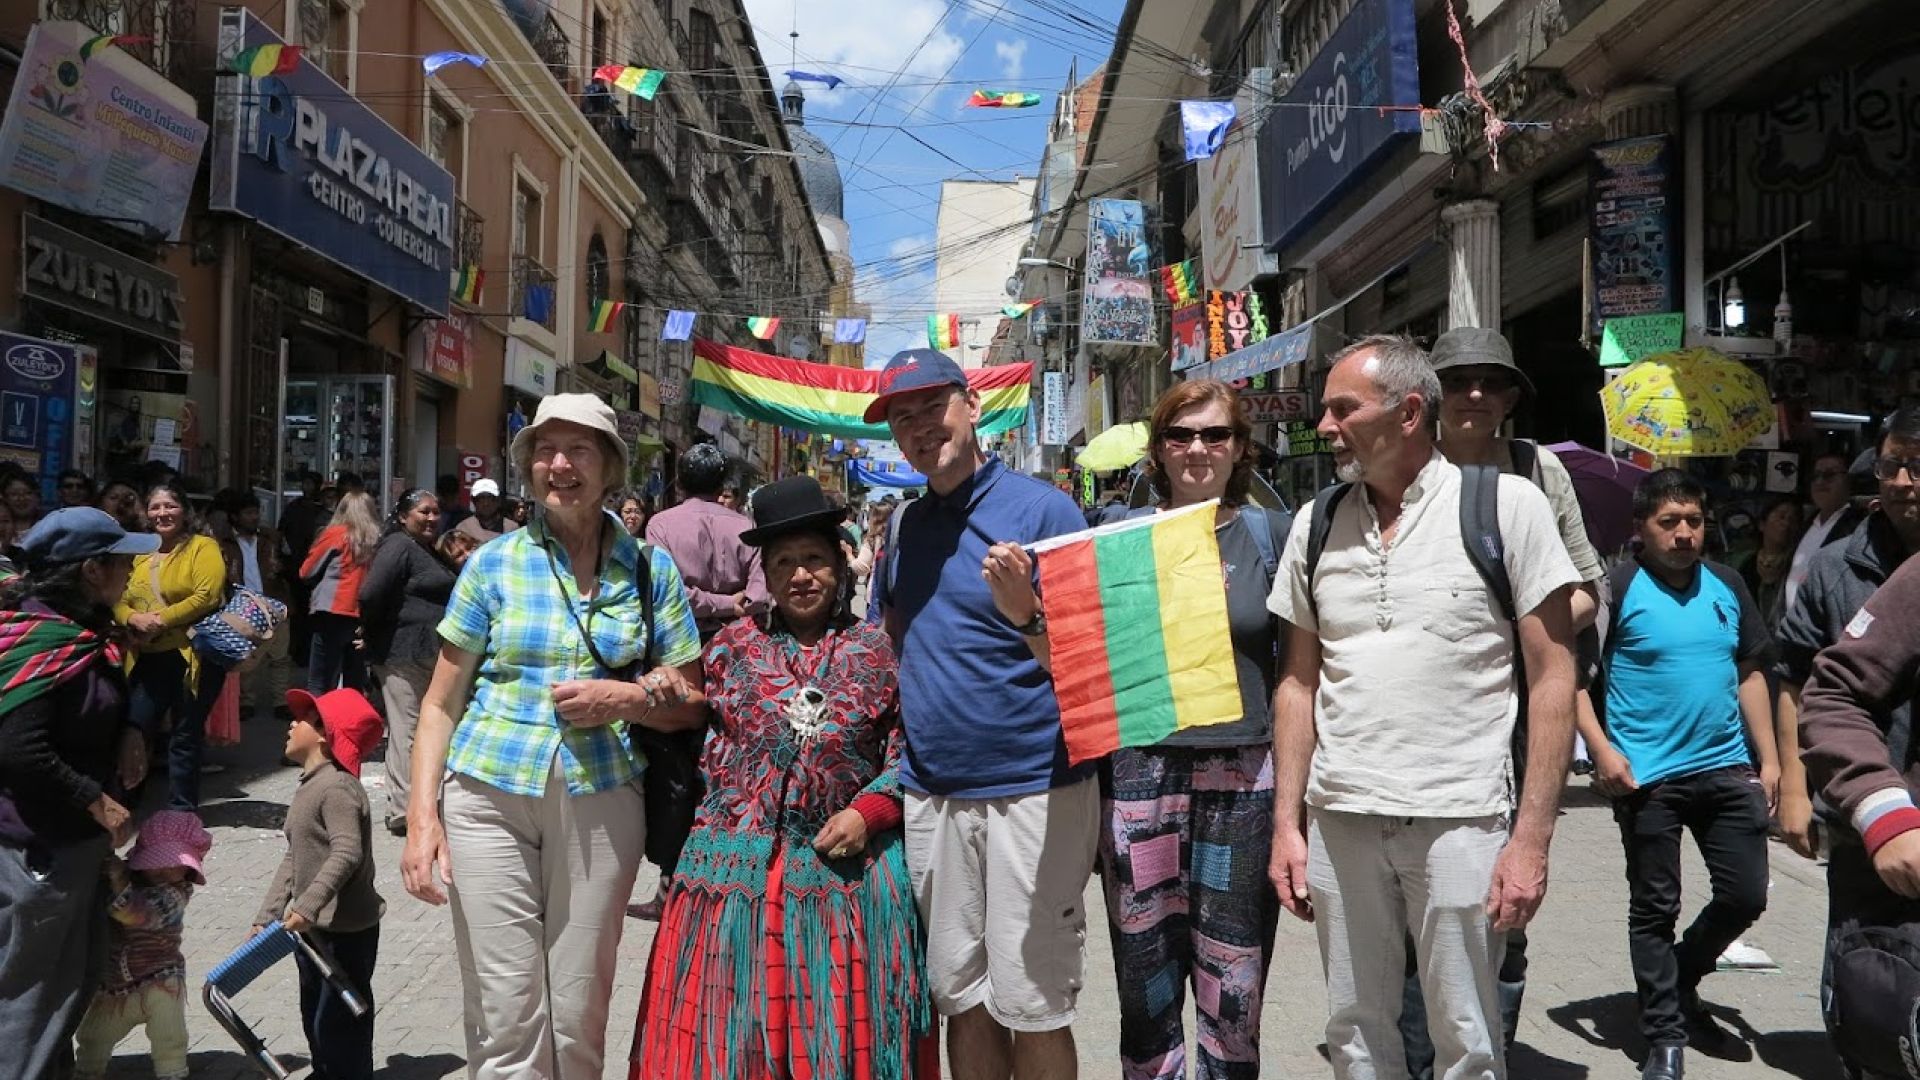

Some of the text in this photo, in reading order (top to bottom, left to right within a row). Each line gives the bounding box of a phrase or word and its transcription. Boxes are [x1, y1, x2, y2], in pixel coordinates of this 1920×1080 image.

[96, 103, 113, 124] Mi
[111, 86, 197, 144] Centro Infantil
[1309, 72, 1348, 158] tigo
[294, 97, 394, 212] PLAZA
[308, 172, 442, 272] CENTRO COMERCIAL
[436, 352, 460, 373] VISION
[1238, 395, 1302, 413] OYAS
